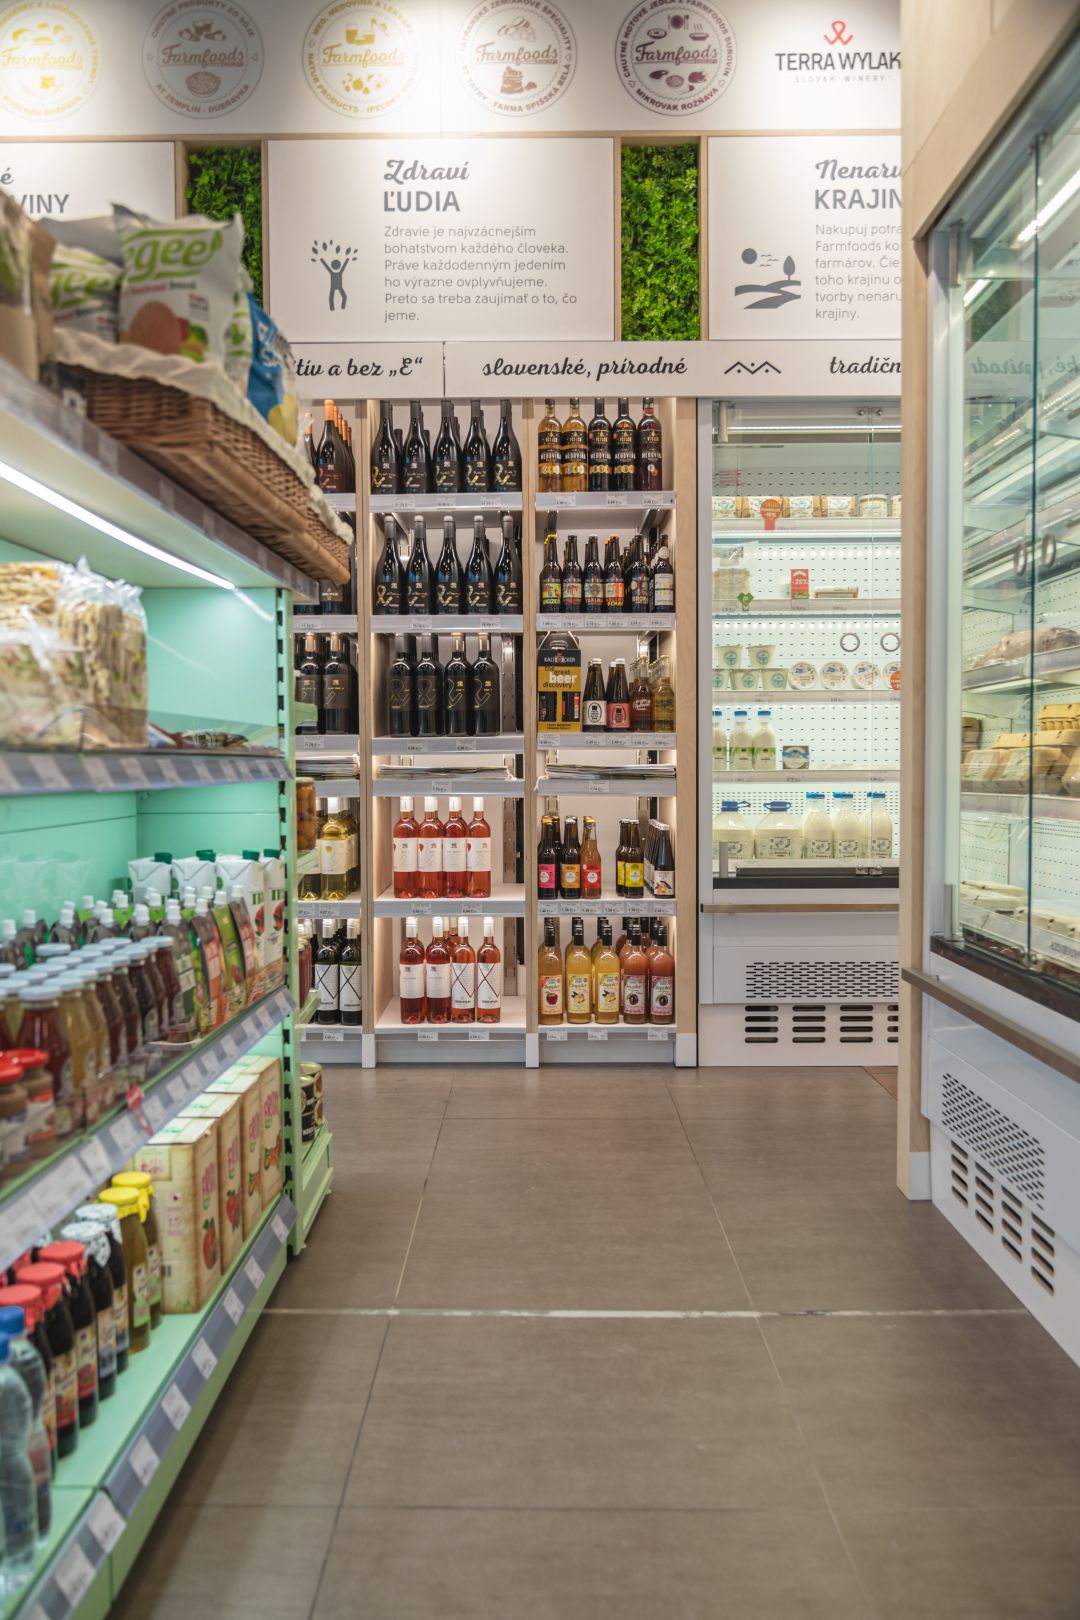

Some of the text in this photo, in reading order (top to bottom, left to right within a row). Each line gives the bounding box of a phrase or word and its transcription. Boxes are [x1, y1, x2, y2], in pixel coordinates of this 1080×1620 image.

[475, 41, 559, 66] Farmfoods
[634, 41, 718, 66] Farmfoods
[775, 52, 835, 71] TERRA
[636, 88, 679, 111] MIKROVAK
[384, 159, 469, 186] Zdraví
[384, 190, 461, 213] ĽUDIA
[385, 226, 430, 237] Zdravie
[433, 226, 447, 239] je
[816, 225, 867, 239] Nakupuj
[384, 243, 568, 254] bohatstvom každého človeka.
[816, 242, 881, 253] Farmfoods
[385, 259, 419, 270] Práve
[424, 259, 511, 273] každodenným
[815, 259, 875, 270] farmárov.
[385, 276, 547, 290] ho výrazne ovplyvňujeme.
[815, 275, 844, 287] toho
[848, 275, 890, 290] krajinu
[385, 293, 418, 304] Preto
[421, 296, 434, 304] sa
[438, 293, 471, 304] treba
[531, 296, 539, 304] o
[543, 293, 557, 305] to,
[561, 293, 577, 304] čo
[815, 292, 854, 305] tvorby
[384, 310, 419, 323] jeme.
[816, 308, 860, 322] krajiny.
[328, 364, 343, 376] a
[347, 358, 384, 376] bez
[482, 356, 688, 382] slovenské, prírodné
[549, 671, 578, 684] beer
